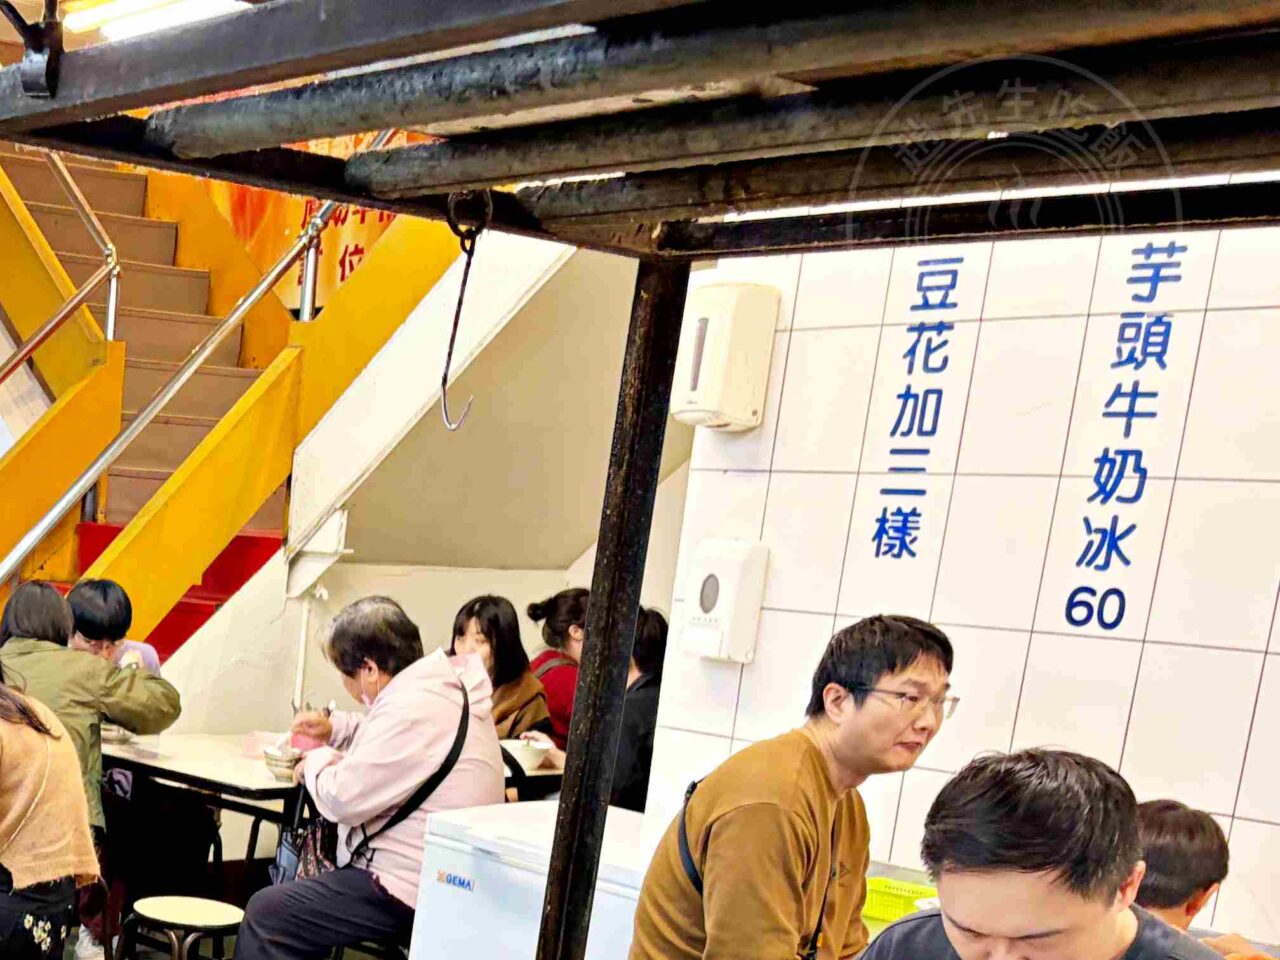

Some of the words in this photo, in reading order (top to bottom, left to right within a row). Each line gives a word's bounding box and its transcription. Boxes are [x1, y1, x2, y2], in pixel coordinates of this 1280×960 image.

[871, 256, 964, 560] 豆花加三樣
[1064, 588, 1126, 630] 60
